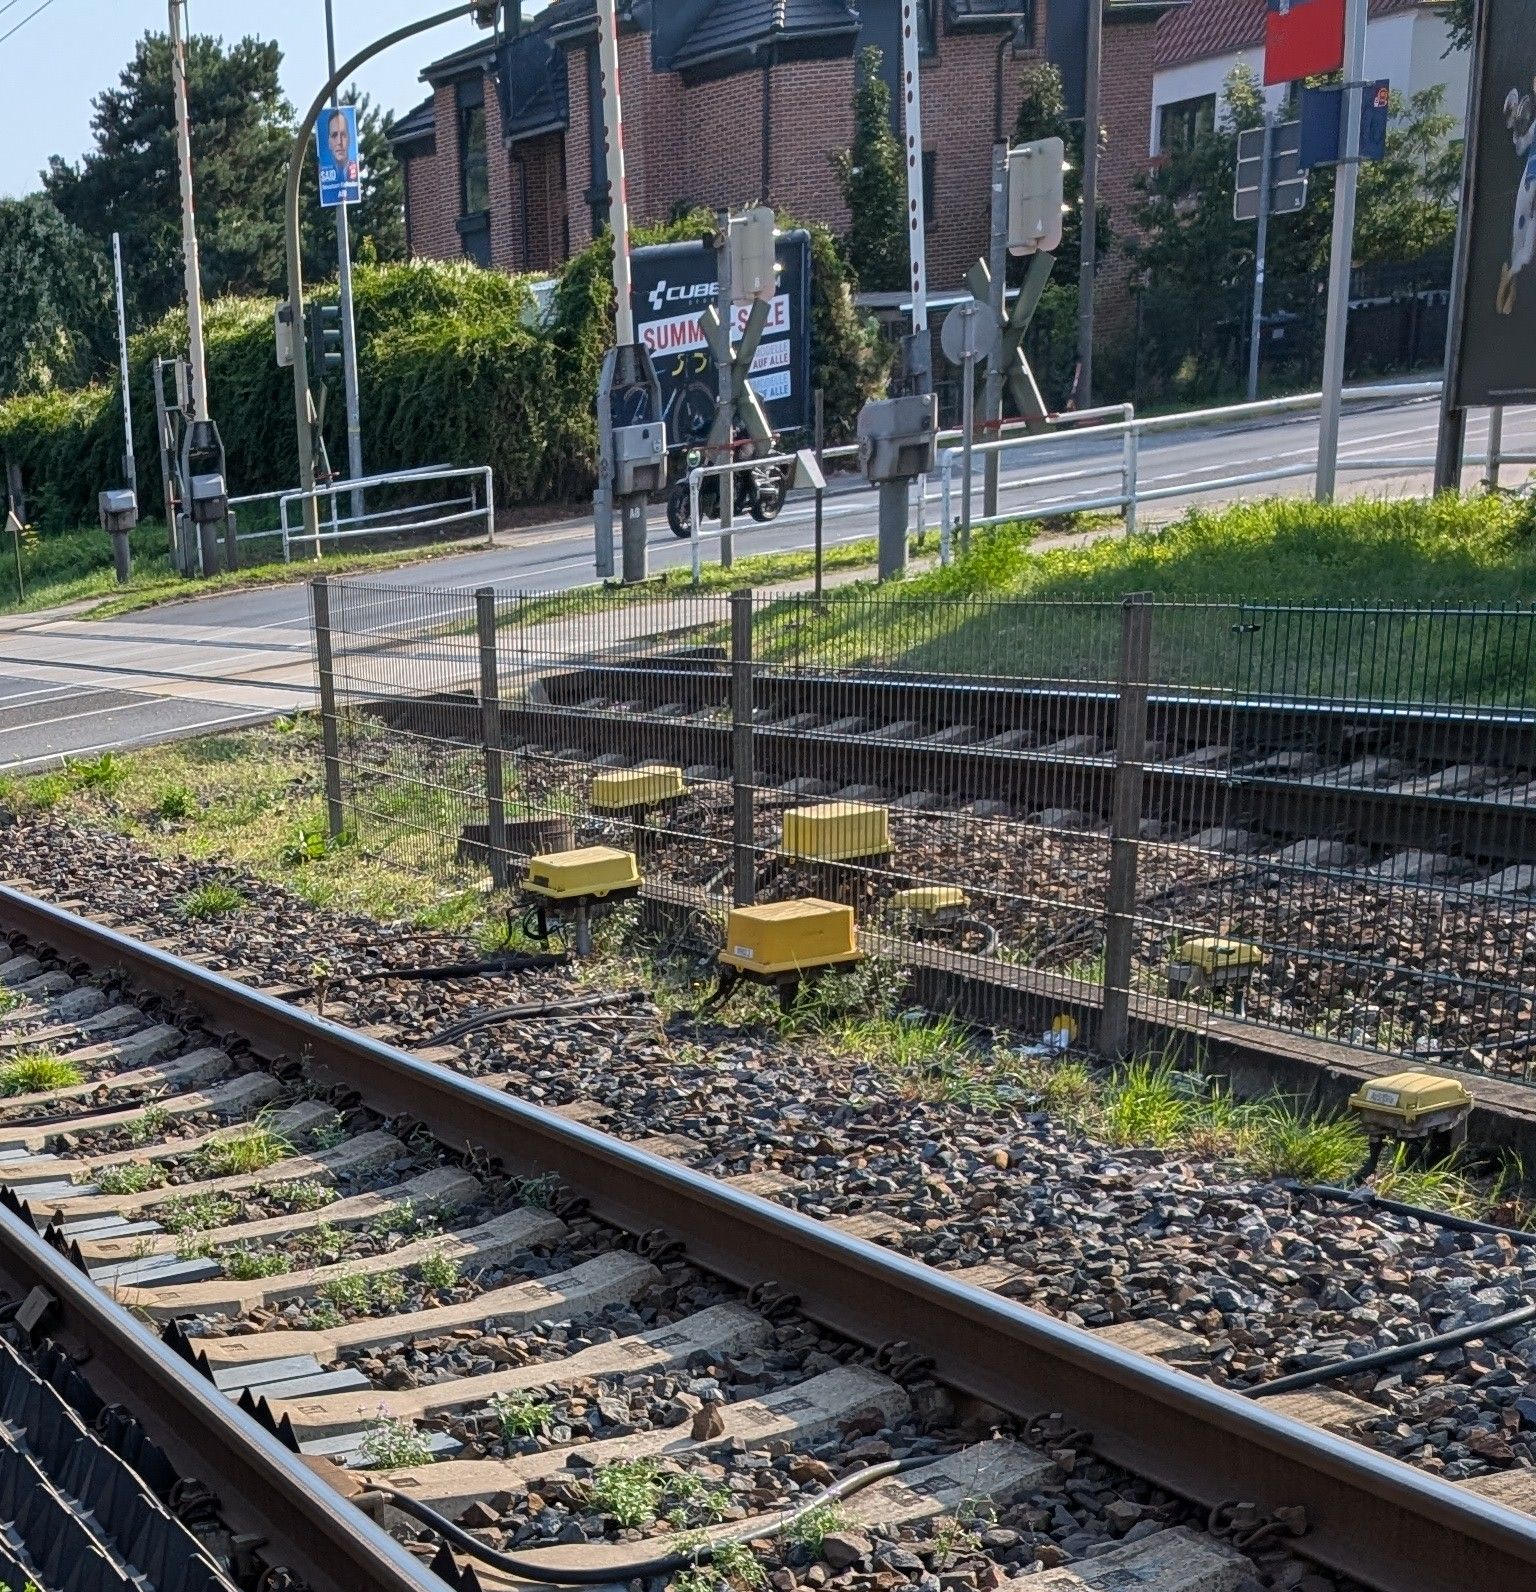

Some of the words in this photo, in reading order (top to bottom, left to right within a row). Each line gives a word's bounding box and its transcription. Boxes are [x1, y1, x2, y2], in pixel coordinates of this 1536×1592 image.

[666, 281, 719, 301] CUBE
[643, 301, 785, 351] SUMM-SE
[769, 352, 789, 367] ALLE
